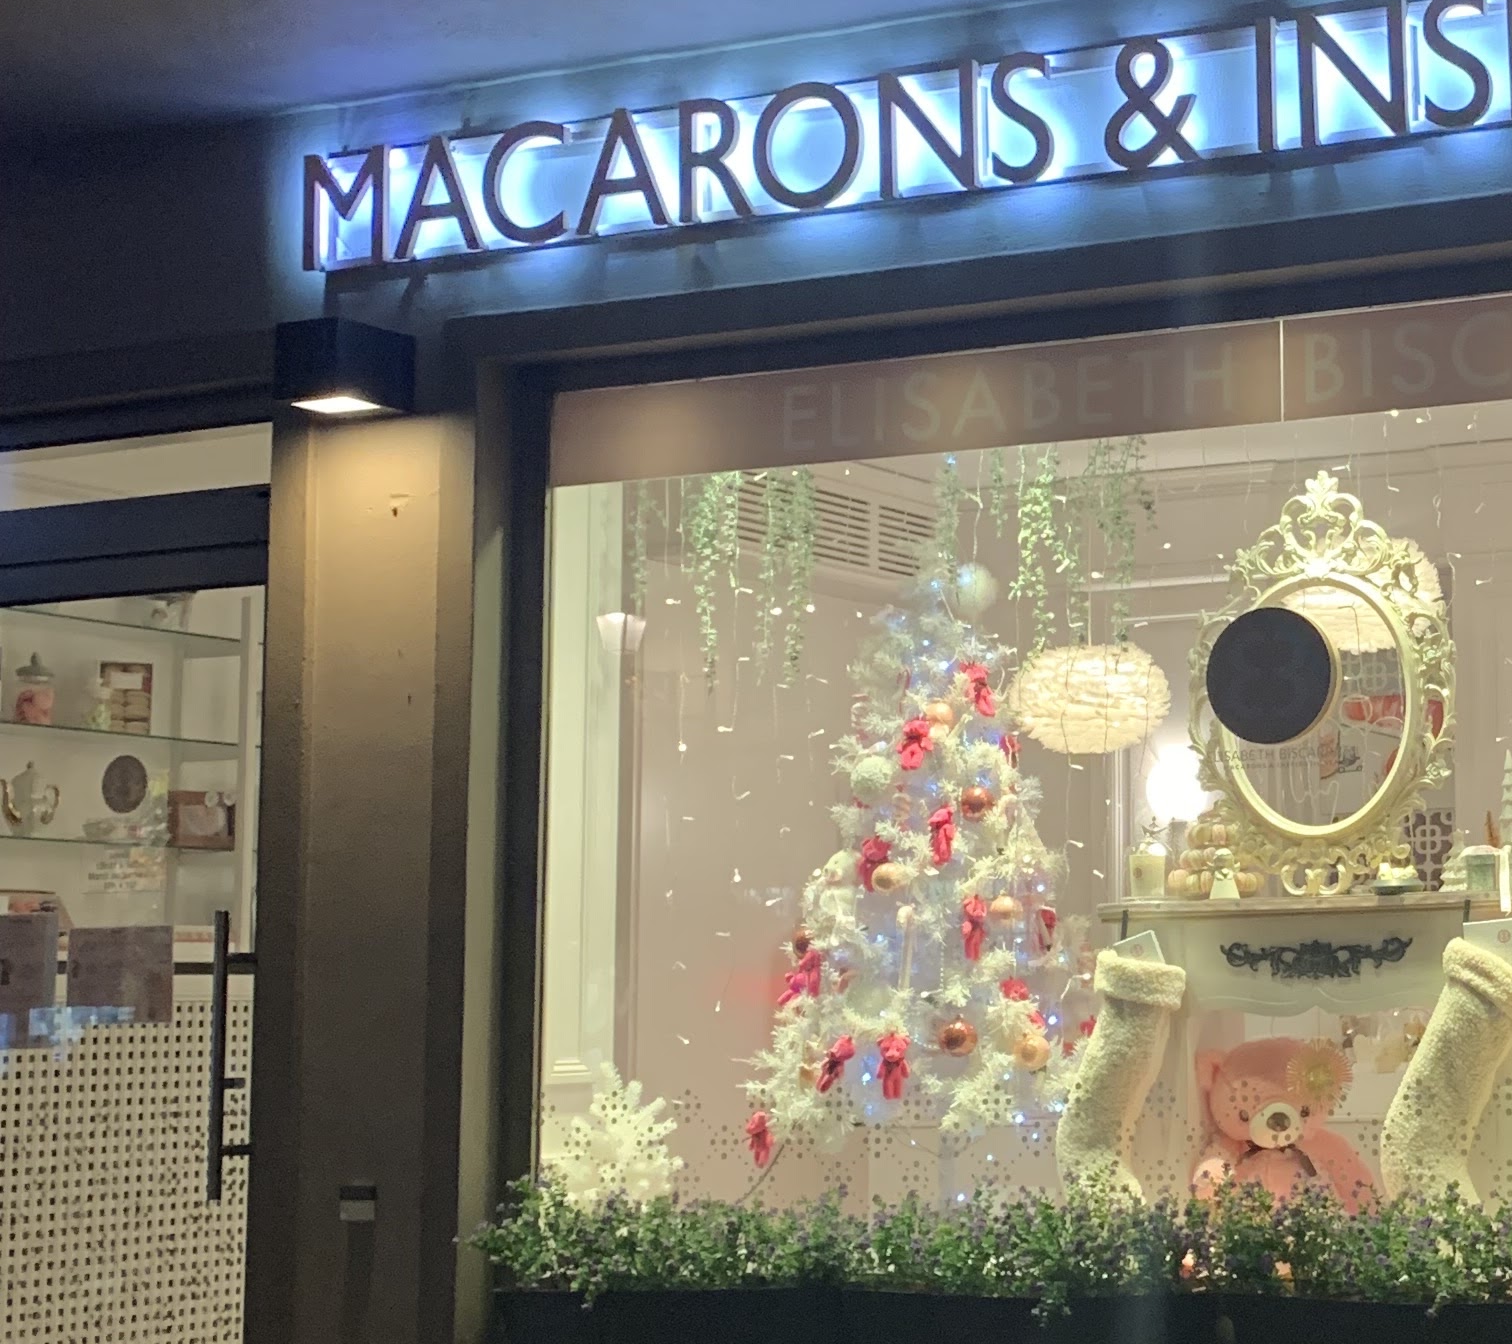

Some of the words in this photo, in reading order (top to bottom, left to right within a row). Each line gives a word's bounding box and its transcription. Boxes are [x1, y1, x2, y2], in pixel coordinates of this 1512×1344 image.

[303, 50, 1055, 271] MACARONS
[1104, 36, 1201, 170] &
[784, 342, 1233, 451] ELISABETH
